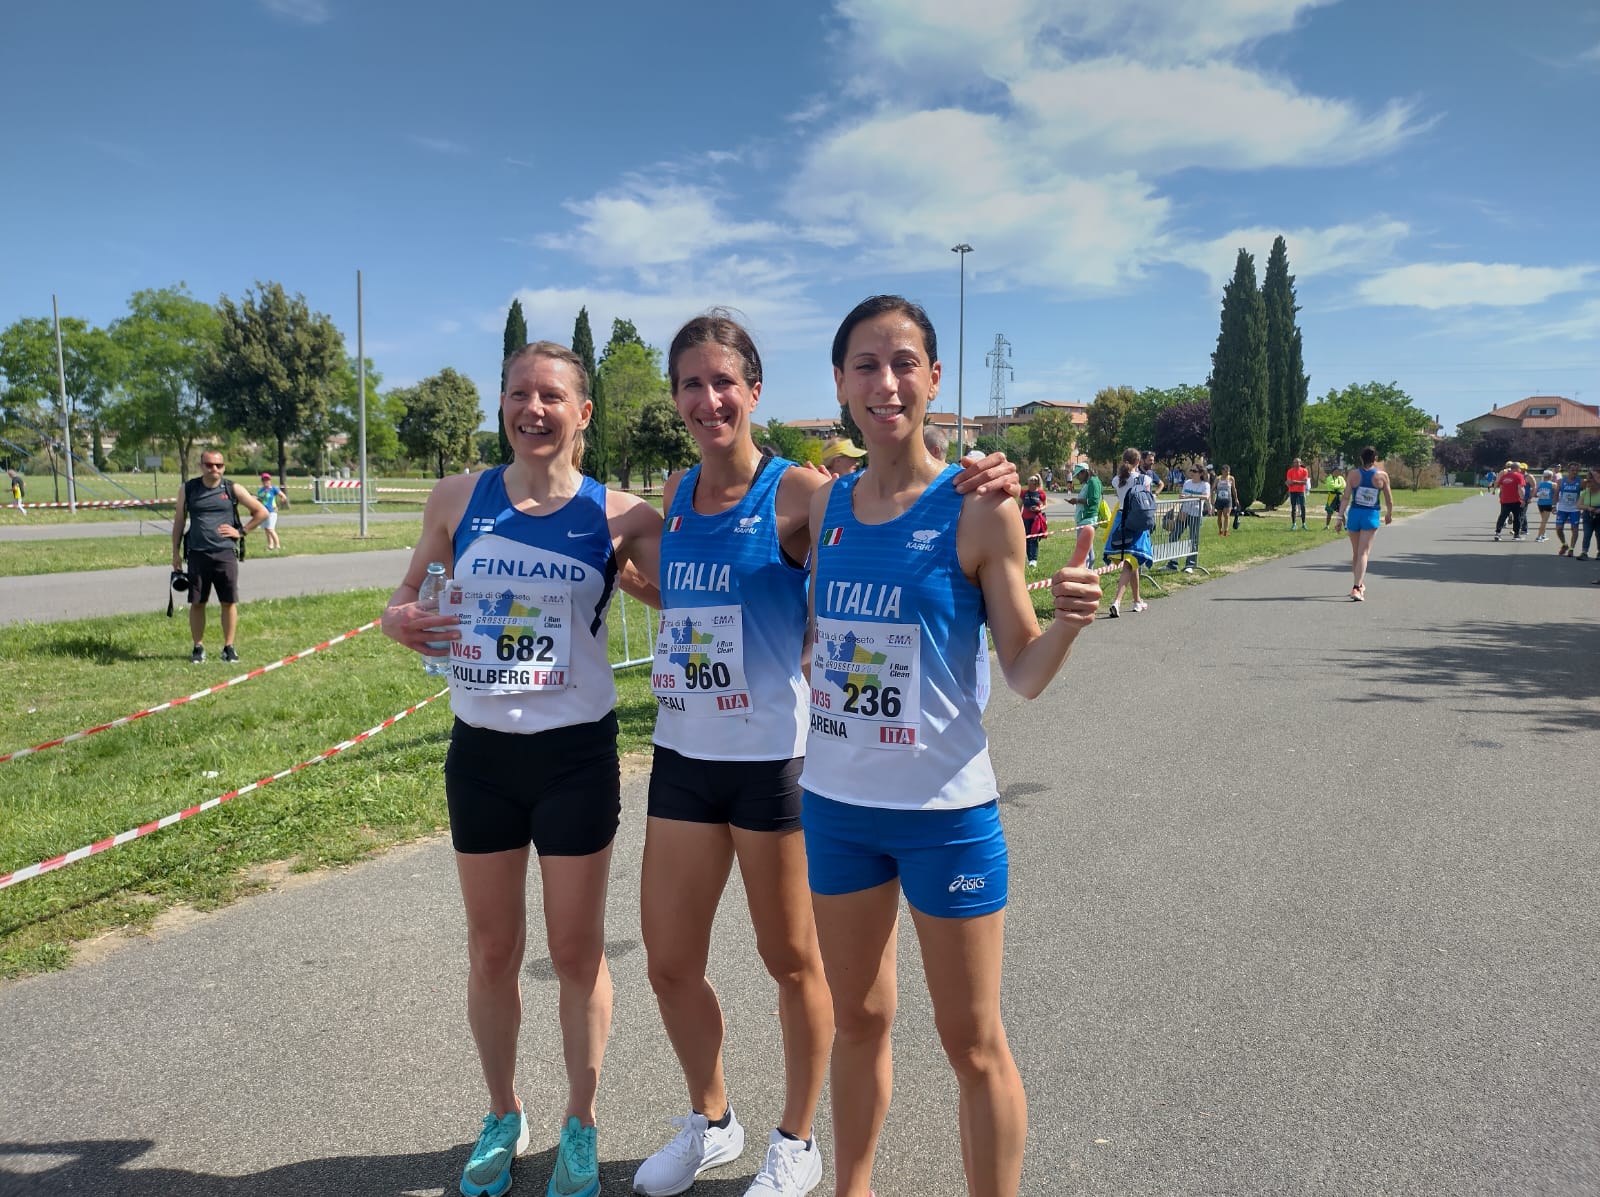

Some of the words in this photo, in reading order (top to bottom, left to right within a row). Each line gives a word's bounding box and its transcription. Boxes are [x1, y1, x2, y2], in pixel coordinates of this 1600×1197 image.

[905, 541, 935, 552] KARHU
[472, 558, 586, 582] FINLAND
[667, 561, 731, 593] ITALIA
[495, 593, 531, 602] Grosseto
[826, 580, 902, 619] ITALIA
[475, 616, 518, 625] GROSSETO
[714, 616, 735, 625] EMA
[838, 634, 875, 644] Grosseto
[888, 635, 912, 645] EMA
[451, 641, 481, 660] W45
[496, 634, 554, 662] 682
[452, 664, 530, 685] KULLBERG
[538, 671, 561, 685] FIN
[653, 673, 675, 689] W35
[685, 661, 731, 690] 960
[889, 670, 910, 678] Clean
[722, 694, 743, 710] ITA
[811, 688, 831, 709] W35
[843, 682, 901, 718] 236
[810, 713, 848, 739] ARENA
[885, 727, 910, 744] ITA
[961, 876, 985, 891] asics
